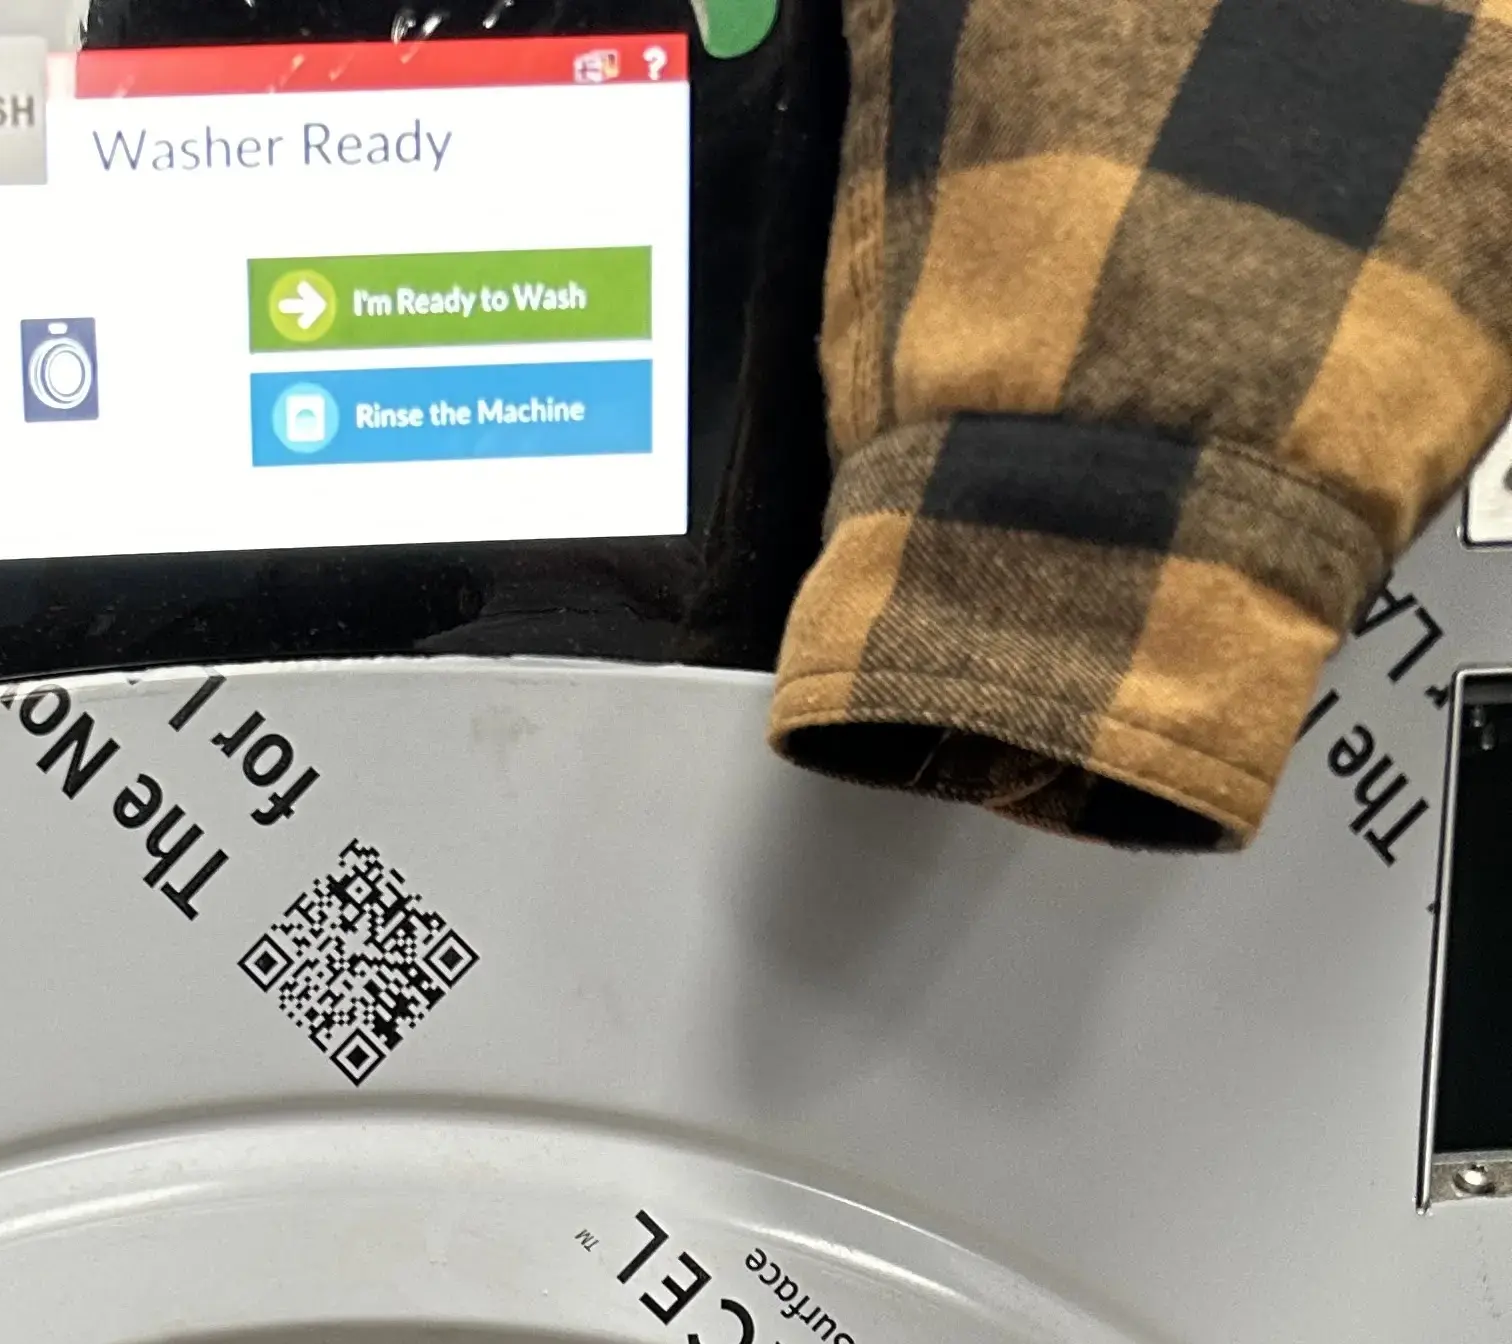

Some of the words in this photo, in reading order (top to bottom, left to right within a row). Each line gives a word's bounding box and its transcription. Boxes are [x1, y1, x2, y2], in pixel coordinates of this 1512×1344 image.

[92, 124, 284, 172] Washer
[302, 117, 453, 173] Ready
[353, 289, 392, 317] I'm
[396, 285, 477, 318] Ready
[479, 286, 510, 312] to
[511, 281, 587, 312] Wash
[356, 401, 424, 429] Rinse
[429, 400, 472, 427] the
[477, 396, 586, 424] Machine
[2, 683, 120, 801] No
[210, 710, 321, 826] for
[1327, 724, 1430, 868] The
[112, 773, 230, 922] The
